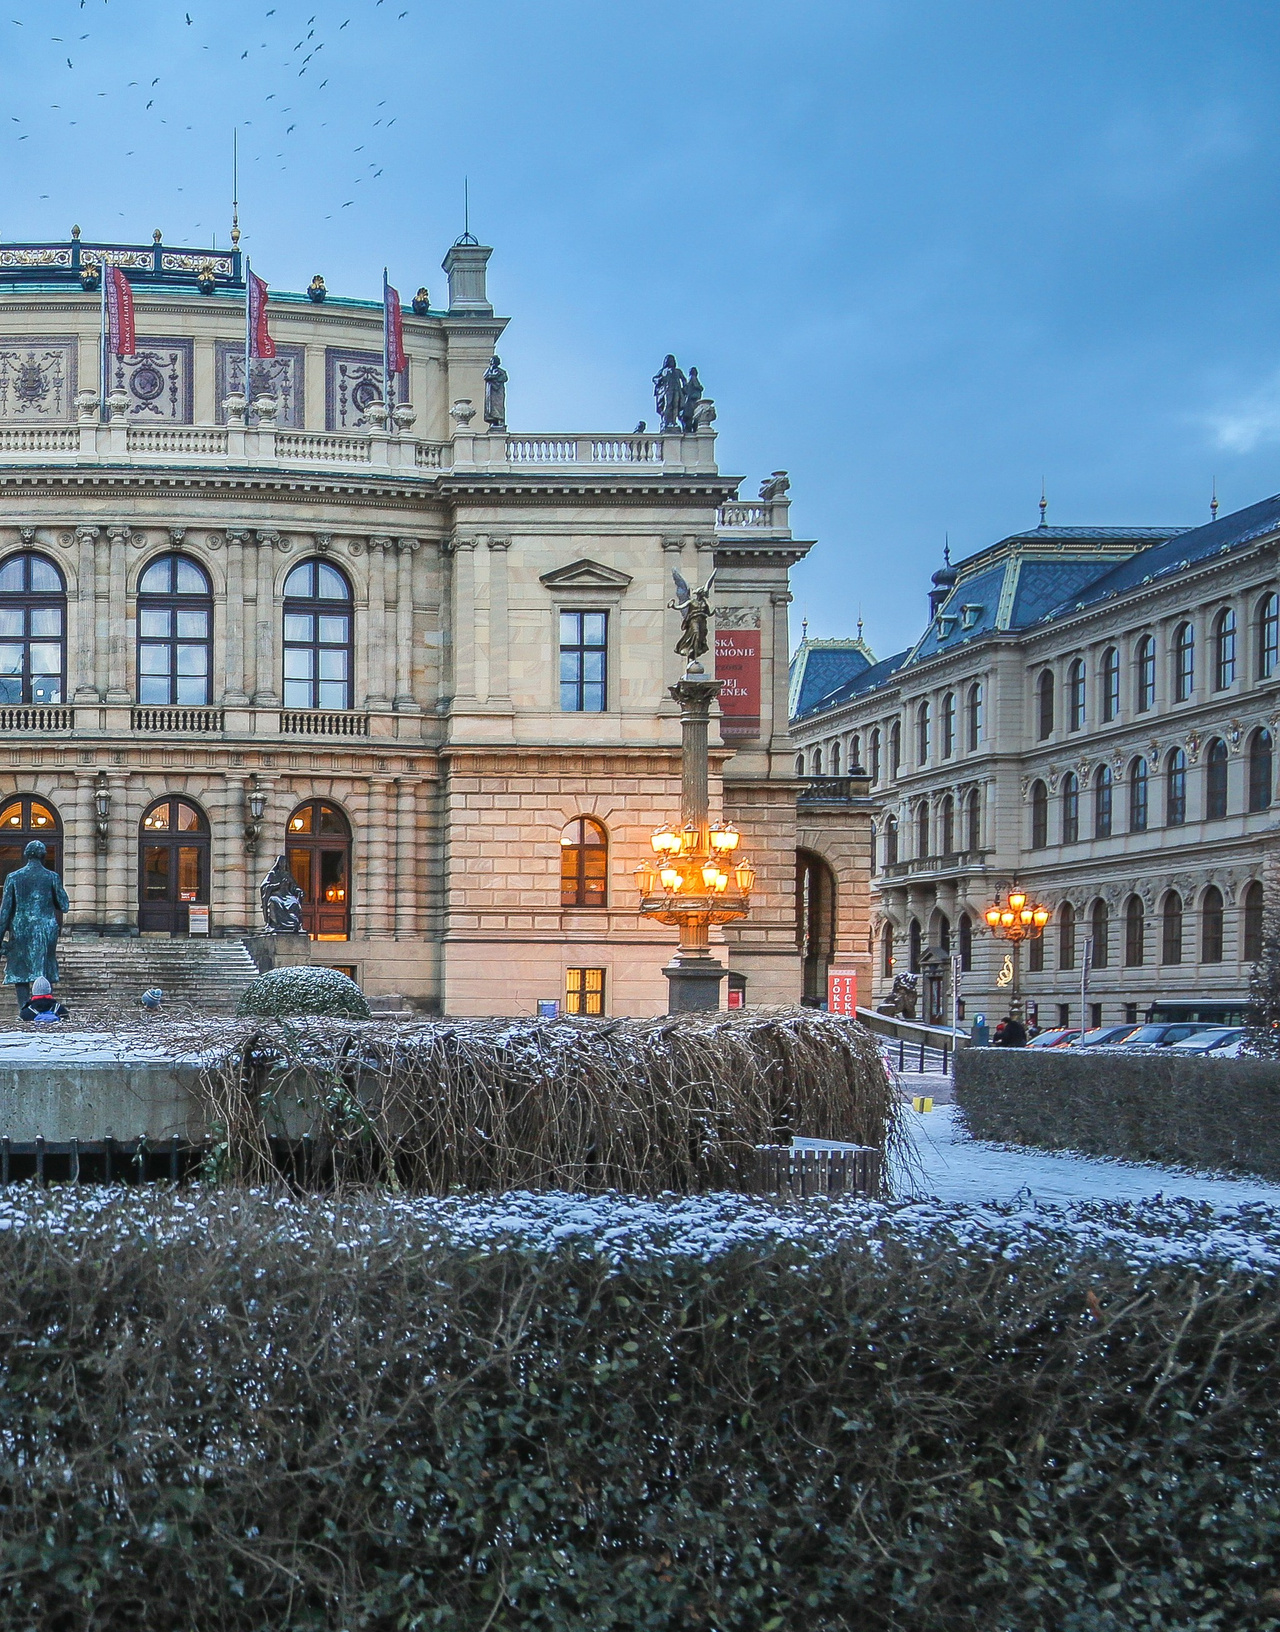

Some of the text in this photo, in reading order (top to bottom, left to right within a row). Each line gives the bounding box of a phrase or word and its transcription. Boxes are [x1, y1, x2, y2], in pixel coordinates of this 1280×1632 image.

[715, 637, 734, 647] SKÁ
[715, 648, 755, 657] RMONIE
[720, 688, 748, 696] ENEK
